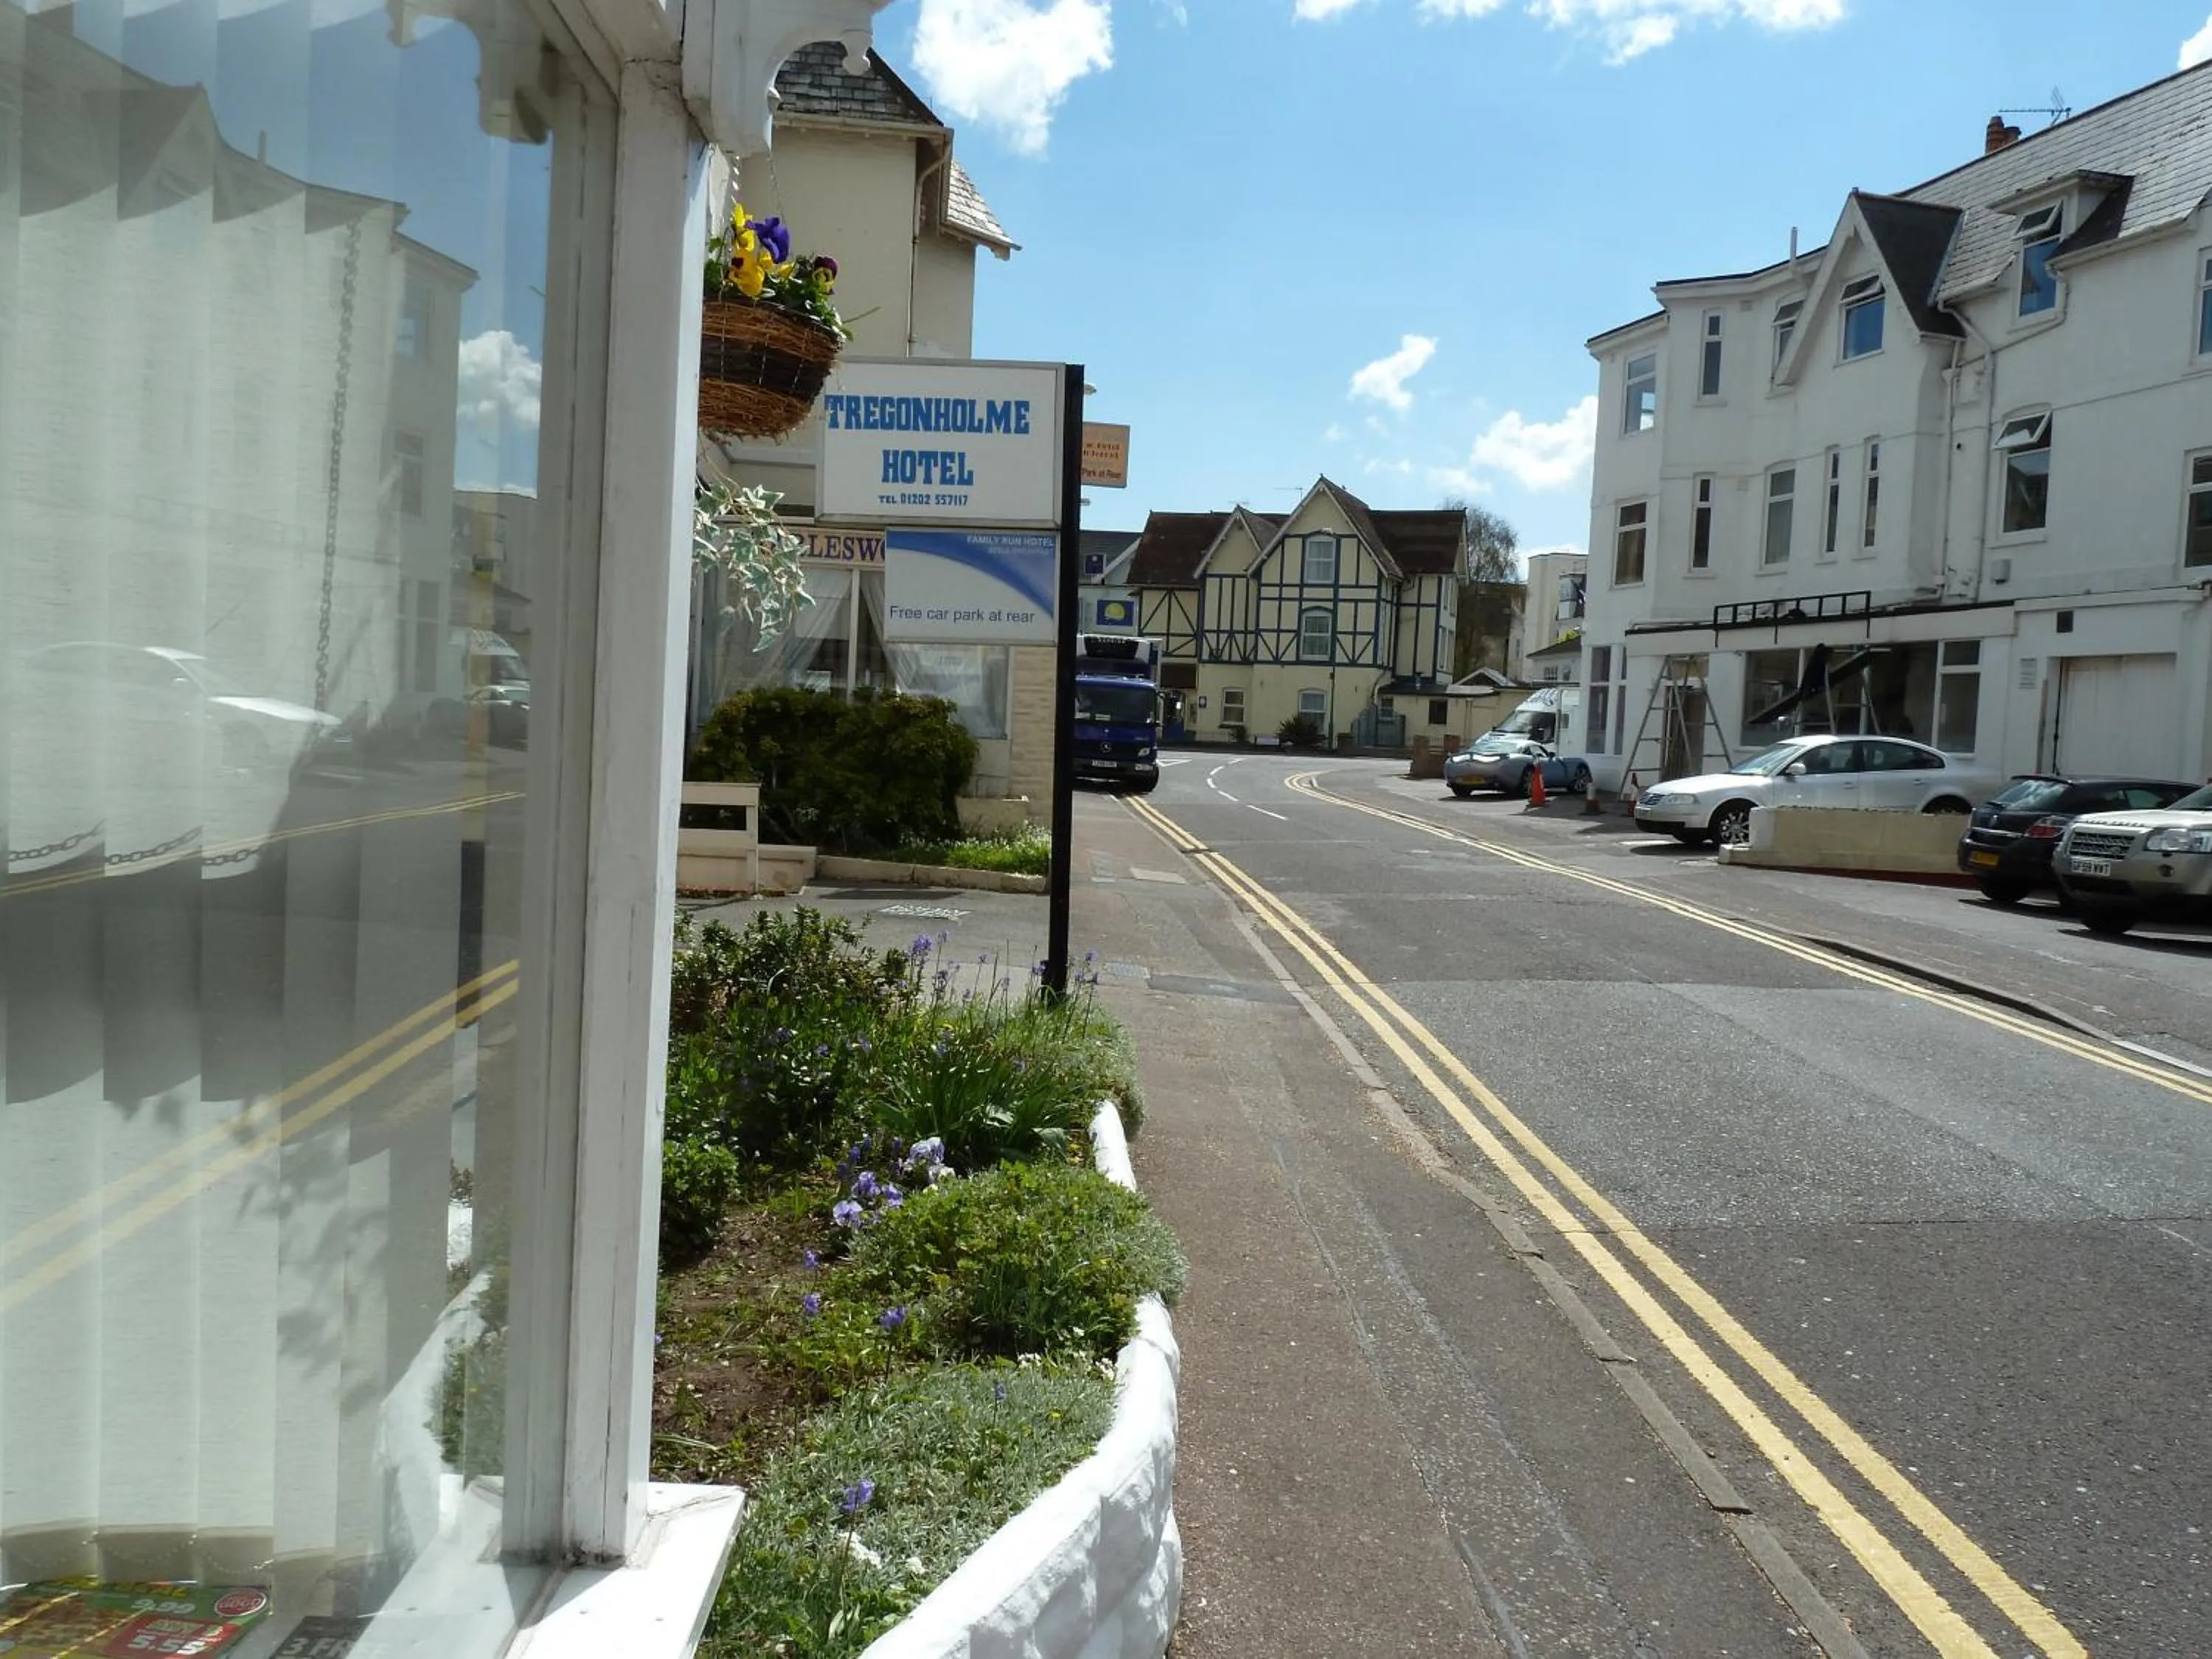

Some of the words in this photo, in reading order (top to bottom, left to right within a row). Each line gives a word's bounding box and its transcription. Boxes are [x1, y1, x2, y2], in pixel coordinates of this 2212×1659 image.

[824, 394, 1030, 434] TREGONHOLME
[882, 449, 974, 486] HOTEL
[878, 495, 897, 504] TEL
[900, 493, 931, 505] 01202
[967, 535, 1000, 544] FAMILY
[1024, 535, 1055, 546] HOTEL
[890, 605, 922, 619] Free
[927, 608, 948, 620] car
[953, 608, 984, 623] park
[988, 609, 1002, 622] at
[1006, 611, 1036, 623] rear
